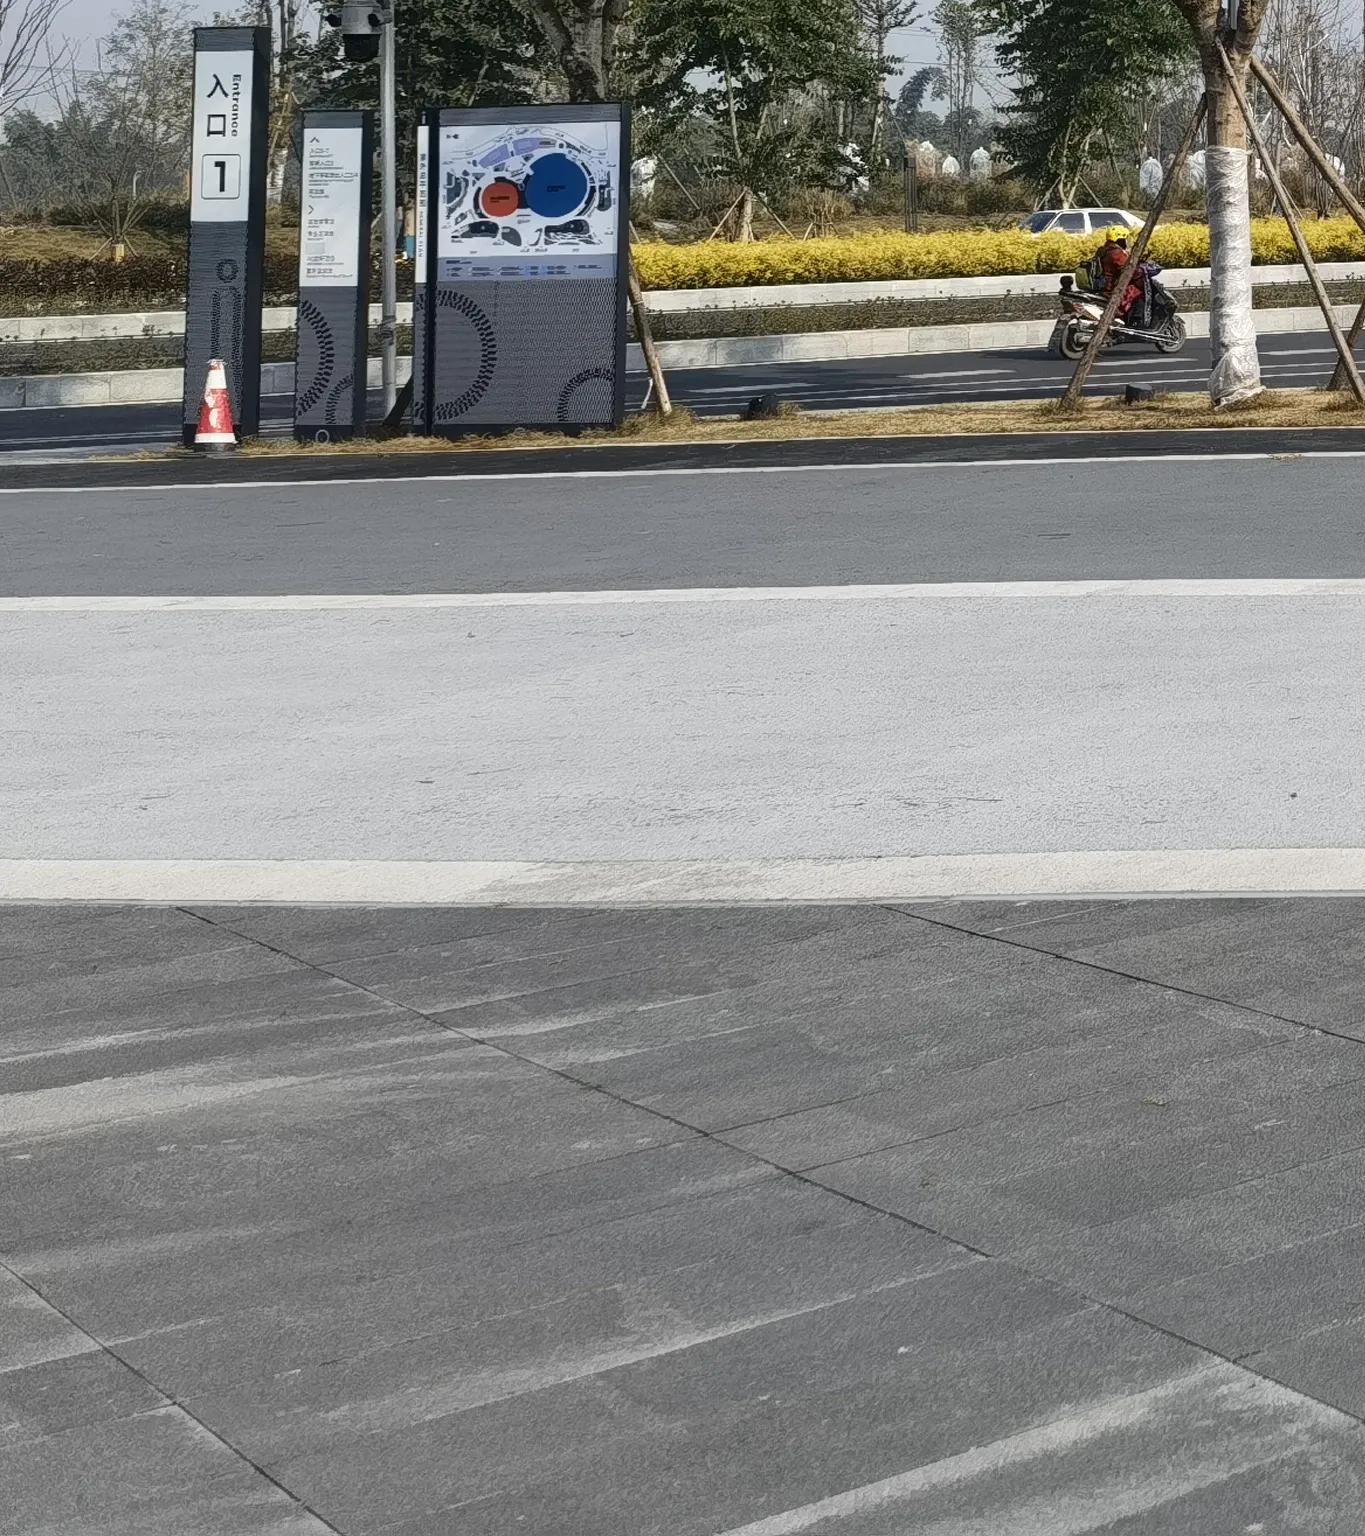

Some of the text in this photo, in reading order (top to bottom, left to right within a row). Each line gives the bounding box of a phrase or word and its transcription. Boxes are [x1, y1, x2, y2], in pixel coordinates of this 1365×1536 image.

[206, 73, 229, 137] 入口
[231, 73, 242, 137] Entrance
[214, 161, 226, 193] 1
